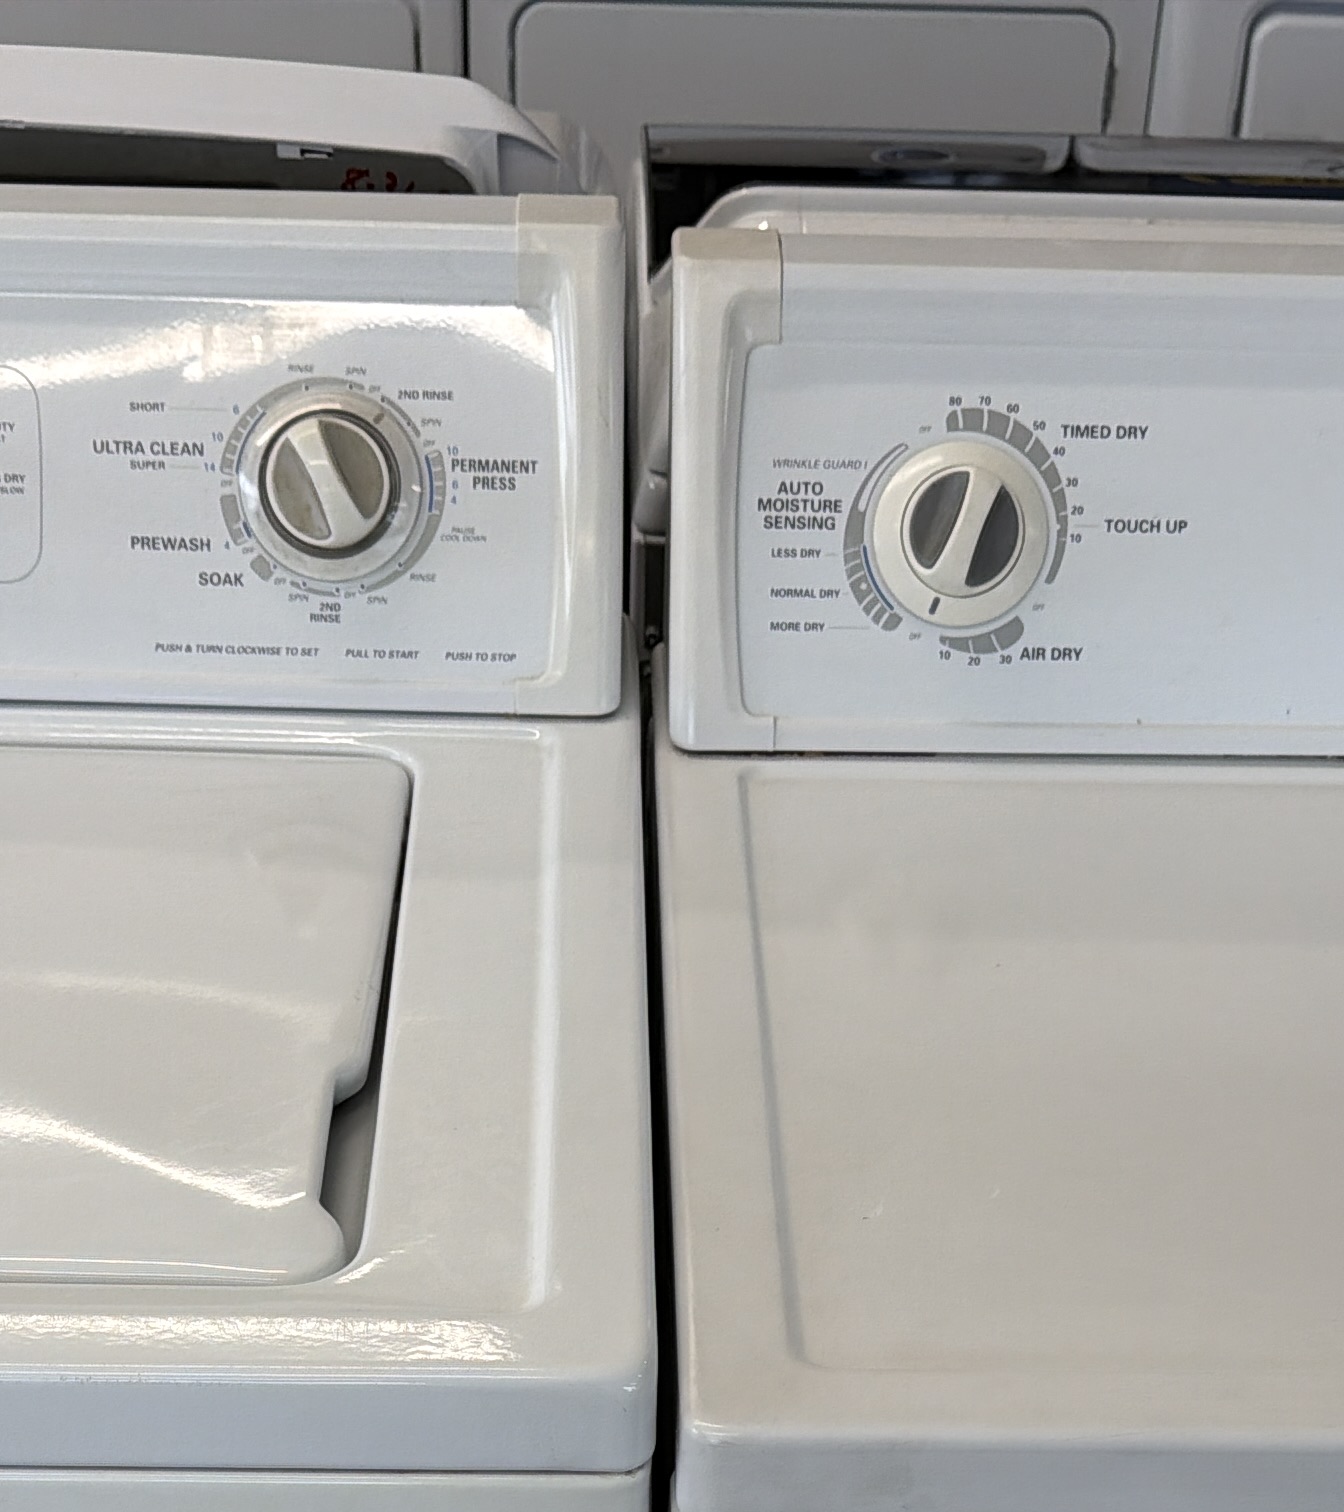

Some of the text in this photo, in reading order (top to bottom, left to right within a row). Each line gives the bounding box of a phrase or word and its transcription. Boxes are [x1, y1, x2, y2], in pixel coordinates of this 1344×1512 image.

[397, 391, 453, 401] 2ND RINSE
[949, 396, 962, 406] 80
[979, 396, 991, 406] 70
[129, 402, 166, 412] SHORT
[1006, 404, 1019, 414] 60
[1033, 421, 1046, 431] 50
[1061, 424, 1148, 440] TIMED DRY
[93, 439, 205, 457] ULTRA CLEAN
[1053, 446, 1066, 456] 40
[129, 460, 166, 470] SUPER
[451, 458, 538, 475] PERMANENT
[772, 459, 861, 470] WRINKLE GUARD
[4, 473, 26, 484] DRY
[473, 476, 516, 491] PRESS
[1066, 477, 1078, 487] 30
[777, 481, 824, 496] AUTO
[757, 498, 843, 513] MOISTURE
[1071, 506, 1084, 516] 20
[763, 515, 836, 530] SENSING
[1104, 519, 1188, 533] TOUCH UP
[130, 536, 211, 552] PREWASH
[1070, 534, 1081, 543] 10
[771, 548, 821, 559] LESS DRY
[198, 572, 244, 587] SOAK
[770, 588, 840, 599] NORMAL DRY
[319, 602, 341, 612] 2ND
[310, 613, 341, 624] RINSE
[770, 622, 825, 632] MORE DRY
[155, 642, 183, 652] PUSH
[195, 644, 223, 654] TURN
[225, 645, 282, 655] CLOCKWISE
[285, 647, 298, 656] TO
[300, 647, 319, 656] SET
[345, 649, 419, 660] PULL TO START
[1019, 647, 1084, 661] AIR DRY
[445, 652, 517, 662] PUSH TO STOP
[939, 650, 951, 660] 10
[999, 655, 1012, 665] 30
[968, 656, 980, 666] 20
